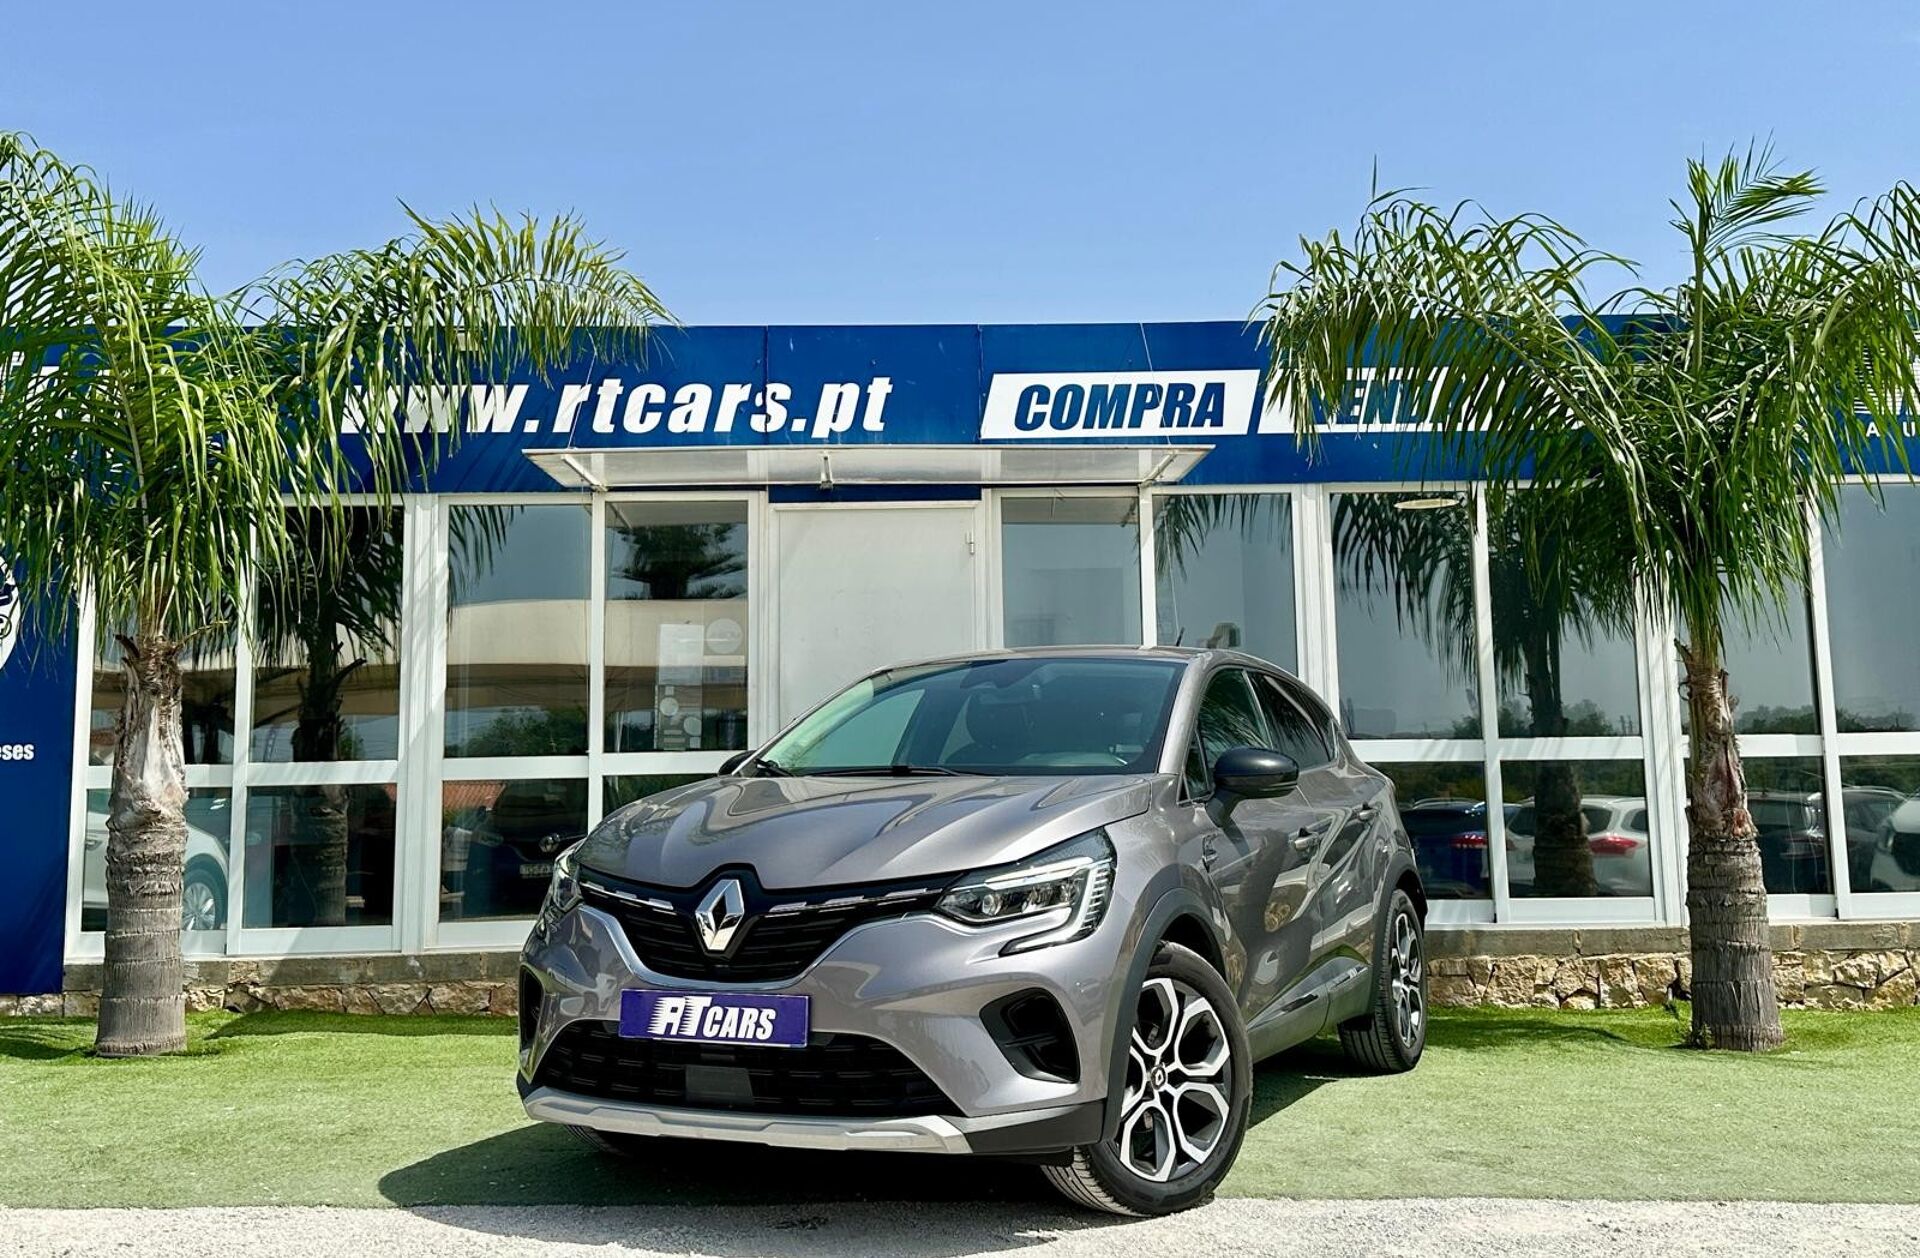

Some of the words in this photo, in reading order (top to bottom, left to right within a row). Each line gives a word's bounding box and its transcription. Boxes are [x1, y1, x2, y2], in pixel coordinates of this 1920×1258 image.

[341, 377, 893, 439] www.rtcars.pt
[1014, 382, 1226, 432] COMPRA
[0, 743, 35, 761] ses
